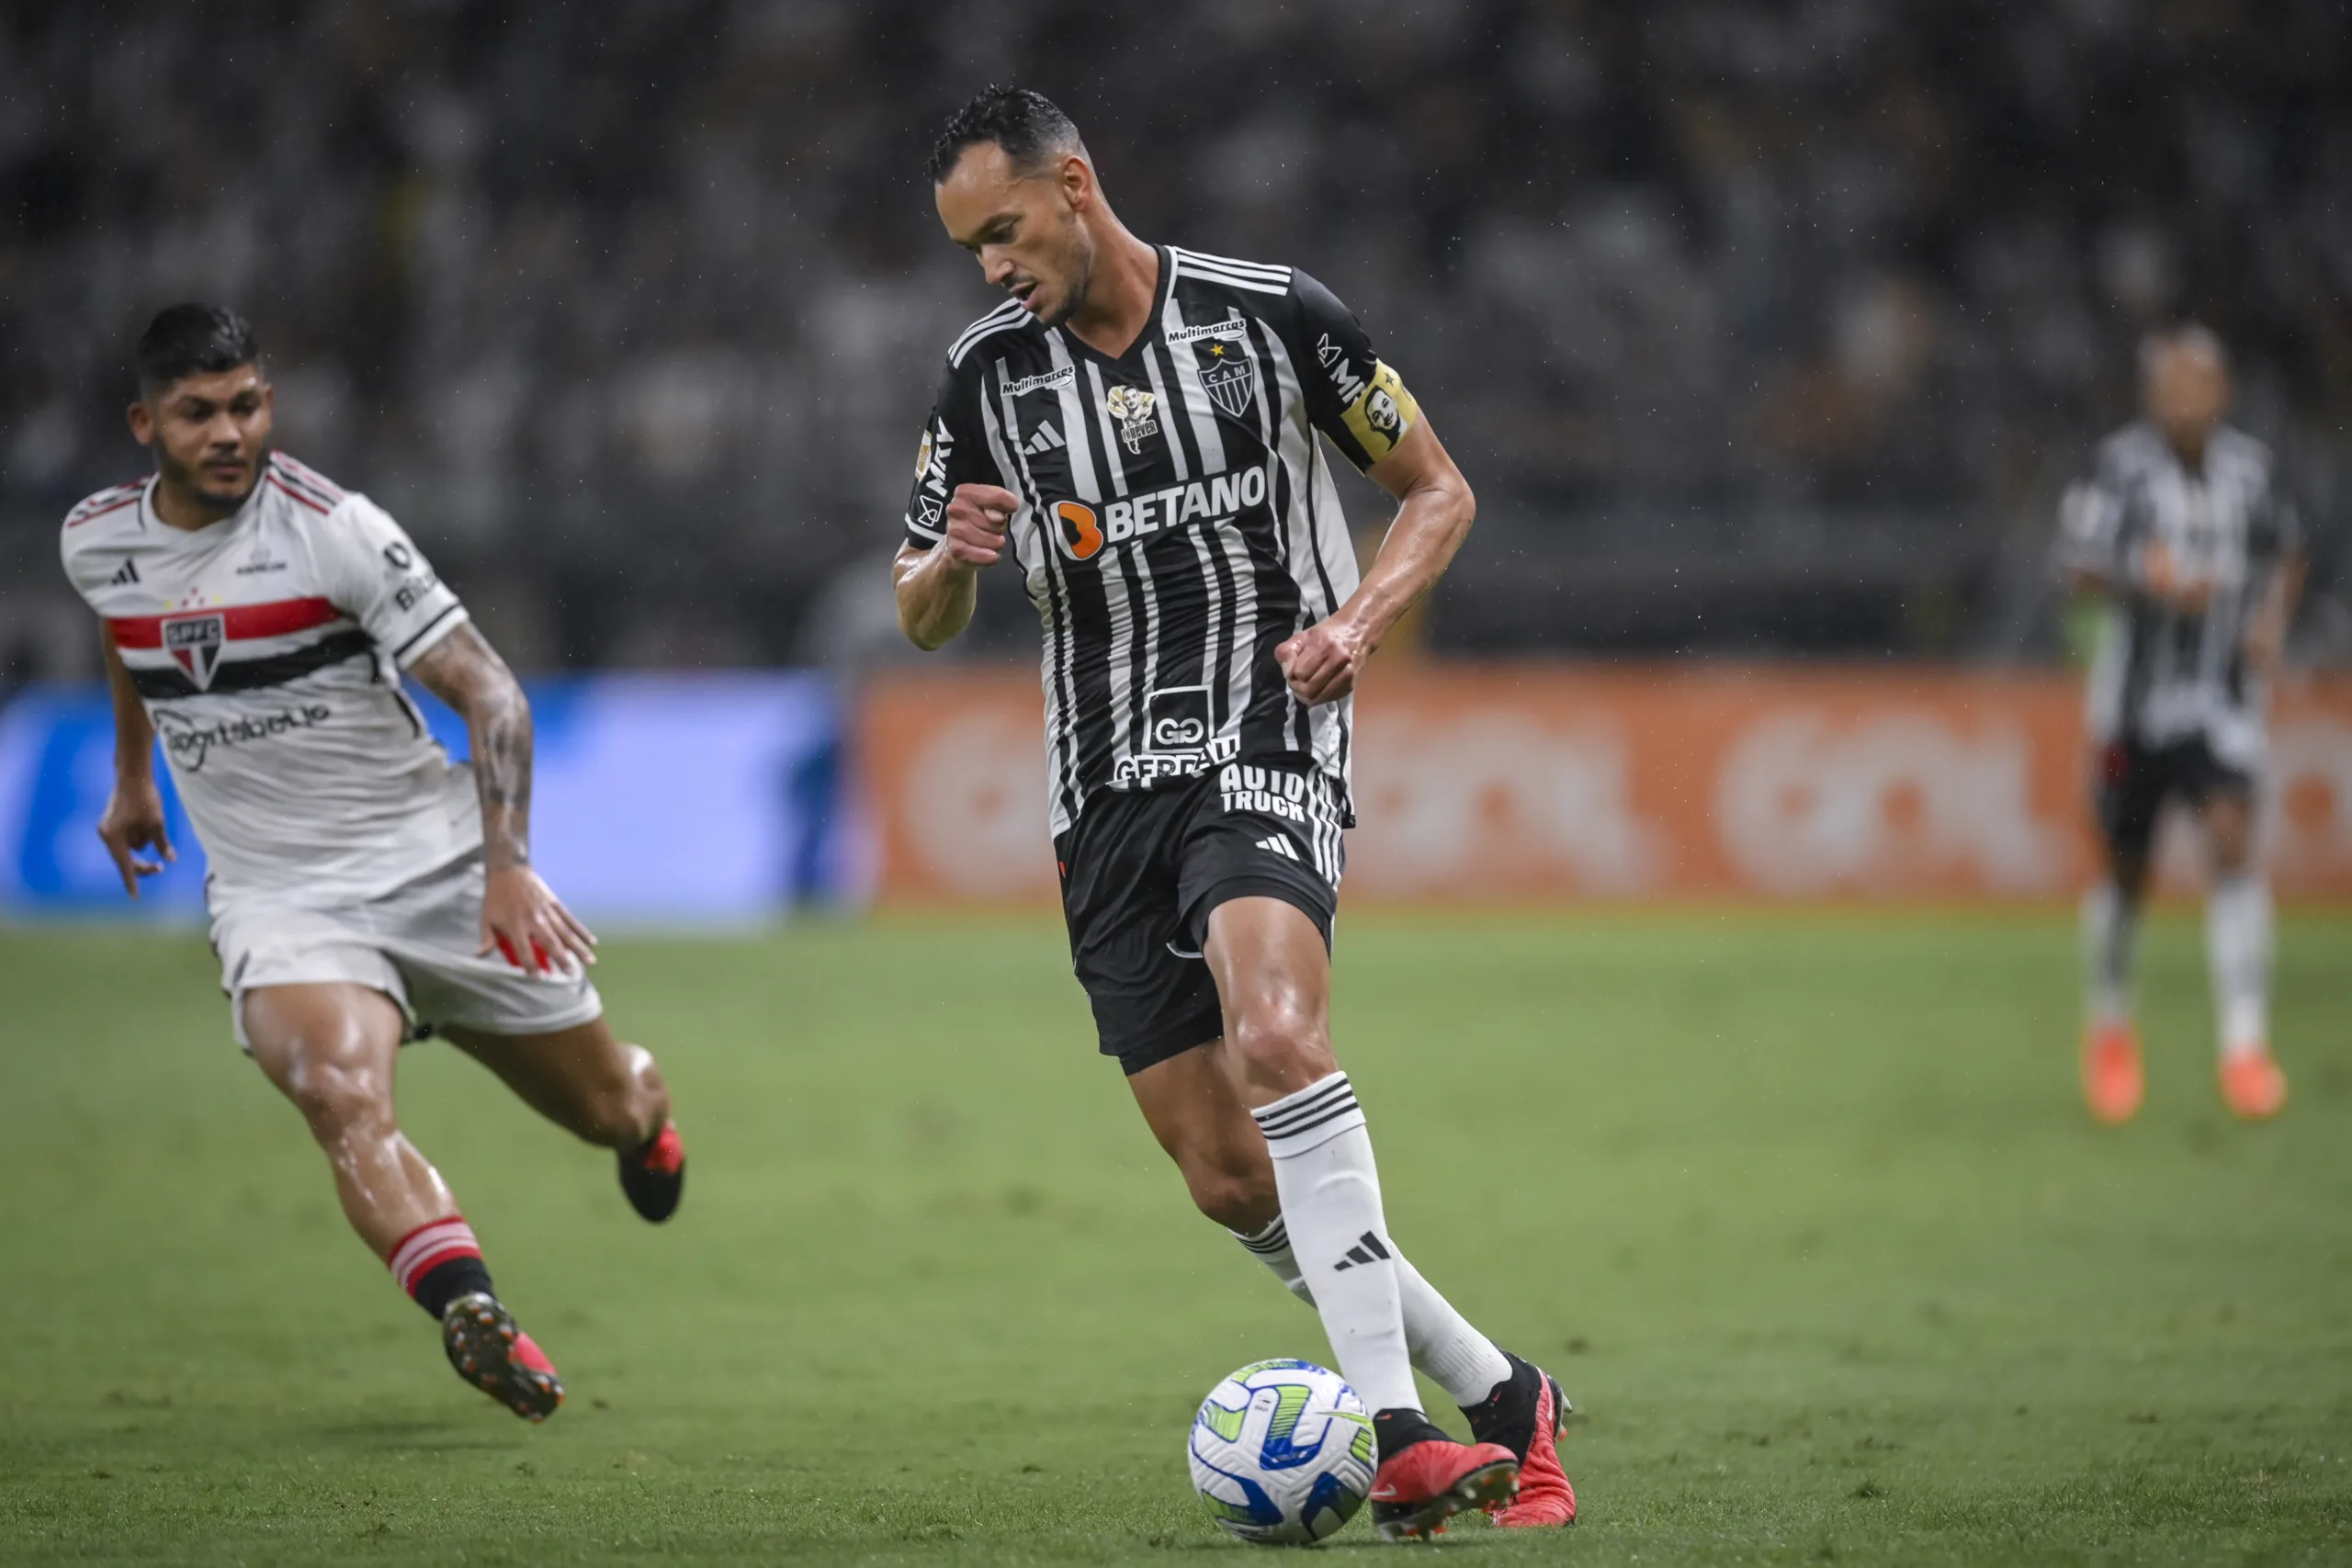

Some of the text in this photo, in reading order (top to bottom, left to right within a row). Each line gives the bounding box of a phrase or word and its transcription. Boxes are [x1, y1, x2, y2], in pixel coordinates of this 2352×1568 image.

[1168, 319, 1246, 343] Multimarcas
[1001, 366, 1073, 394] Multimarcas
[1208, 365, 1246, 383] CAM
[1104, 466, 1266, 543] BETANO
[1220, 790, 1305, 823] TRUCK
